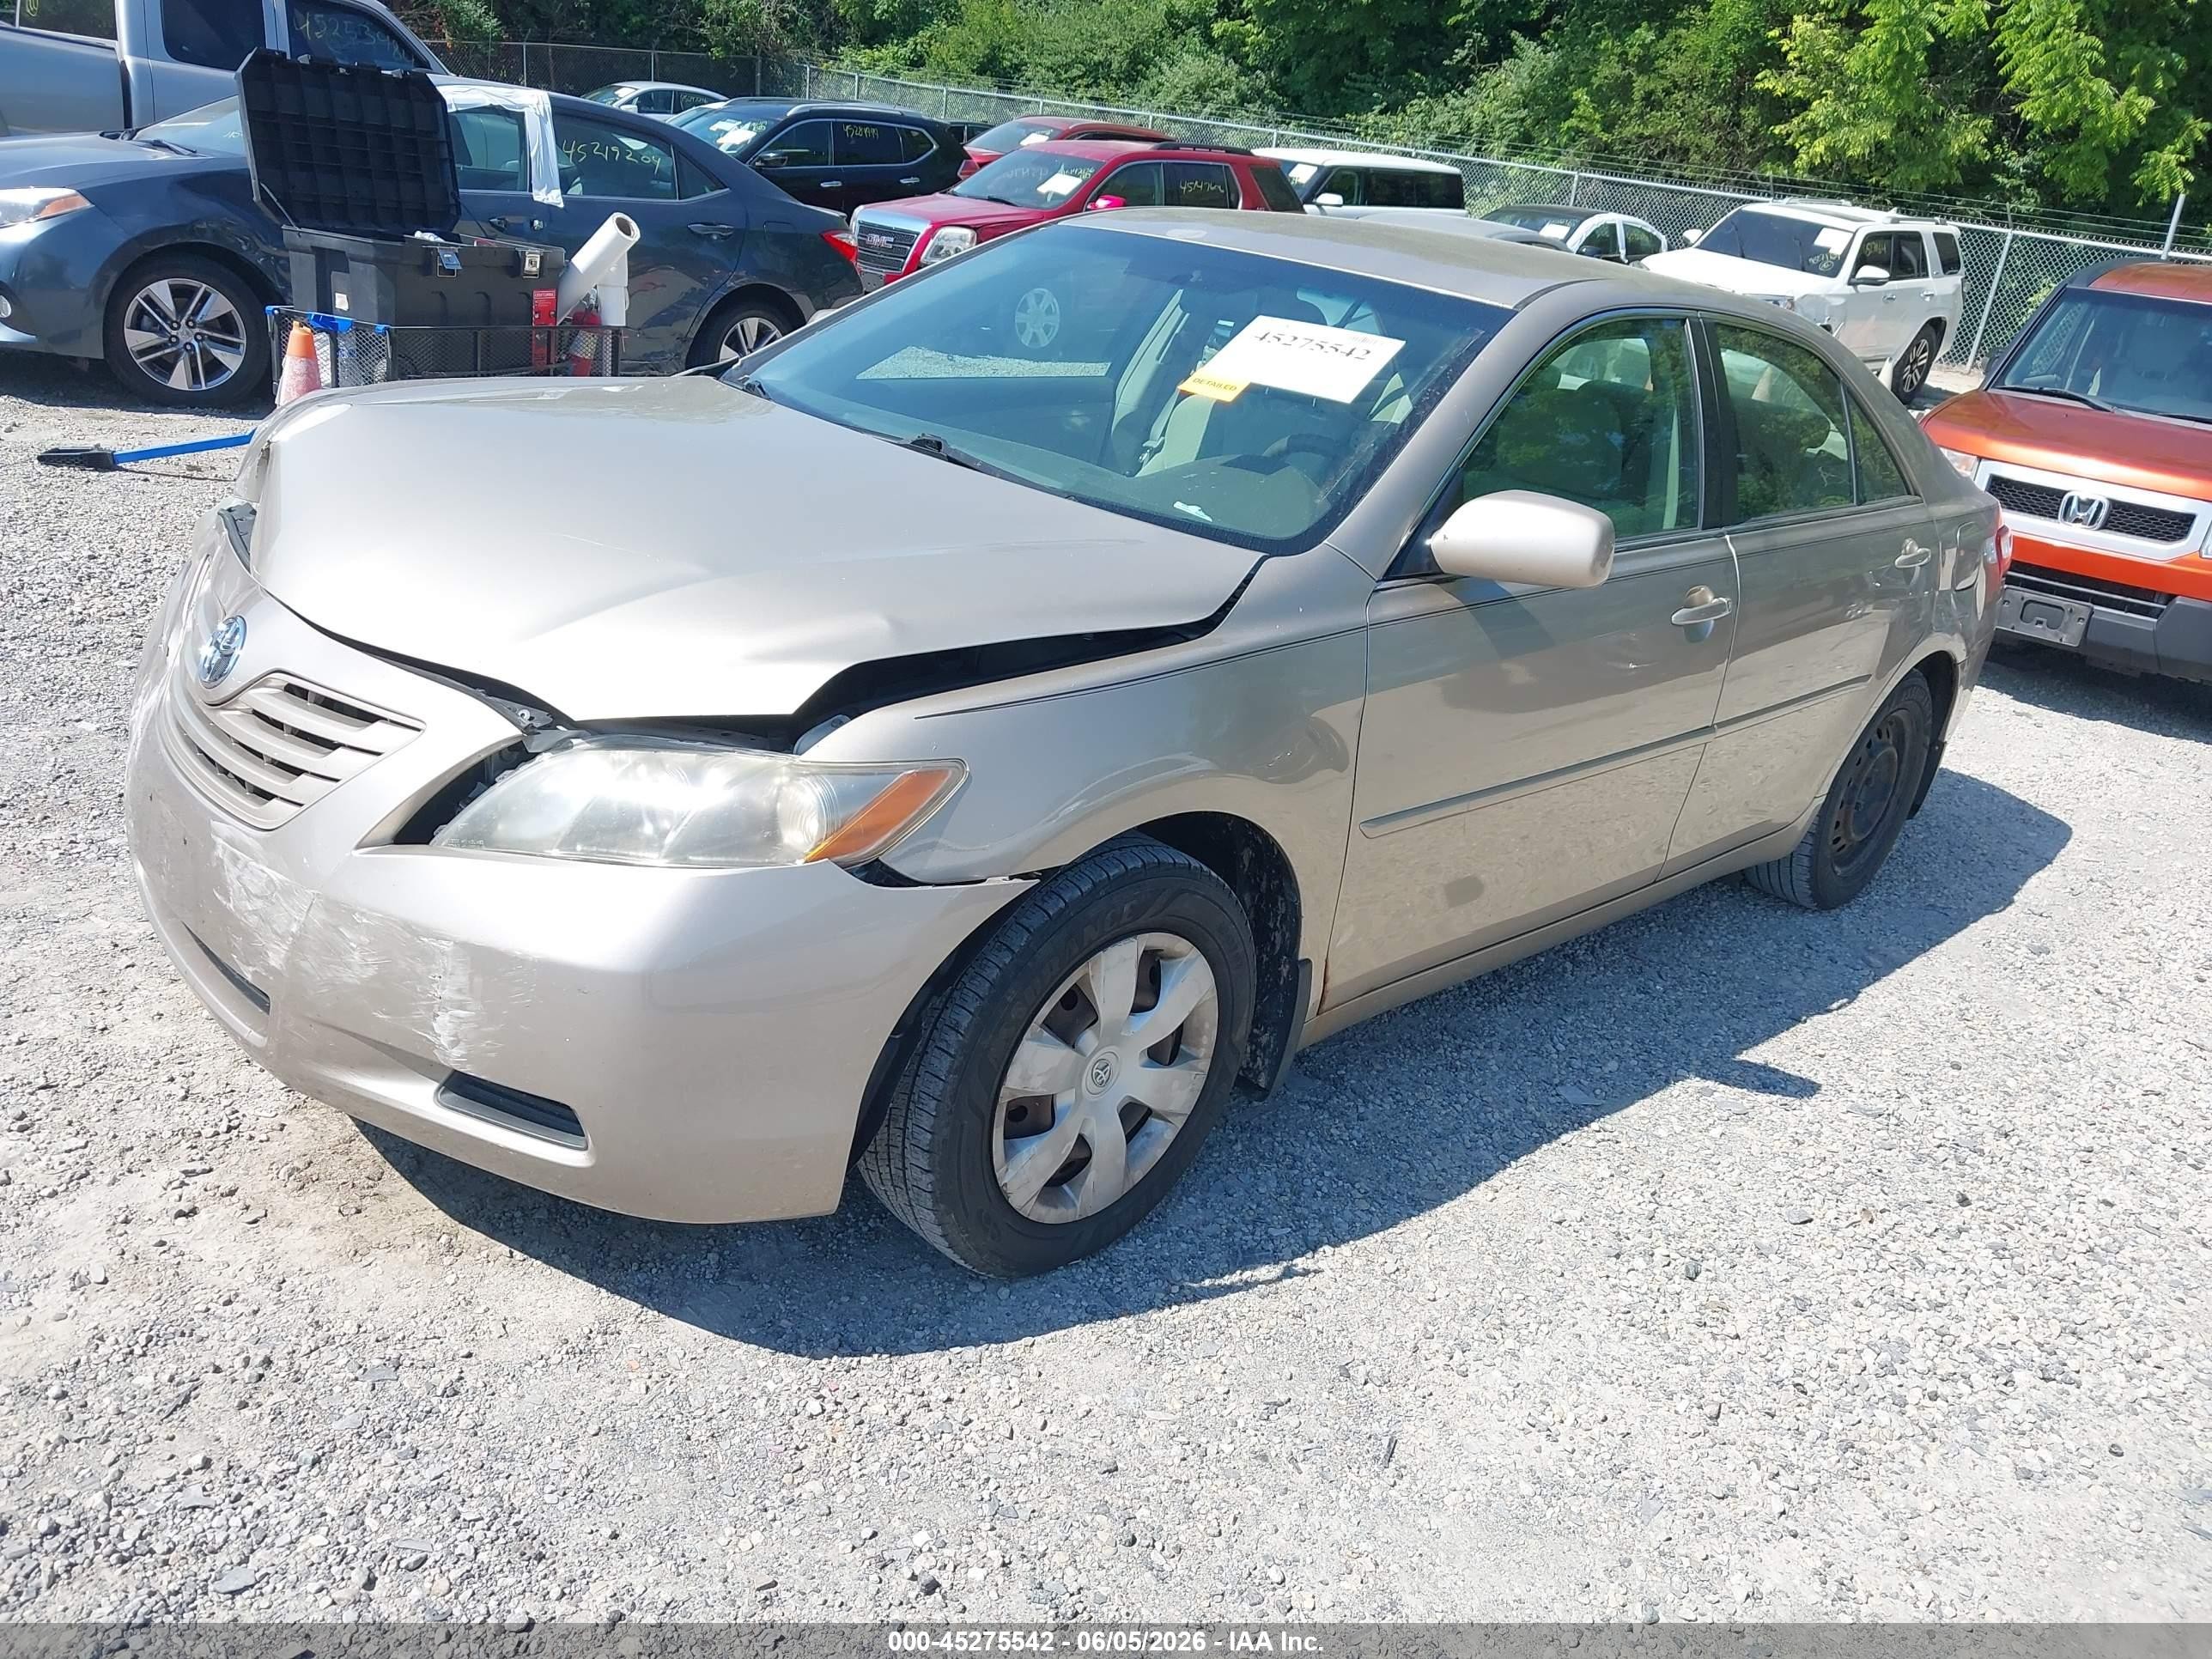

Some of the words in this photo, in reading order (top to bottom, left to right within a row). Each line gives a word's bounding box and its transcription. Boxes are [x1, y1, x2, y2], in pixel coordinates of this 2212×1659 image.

[562, 139, 661, 176] 45219204
[866, 233, 895, 249] GMC
[1250, 331, 1372, 362] 45275542
[1192, 377, 1238, 392] DETAILED
